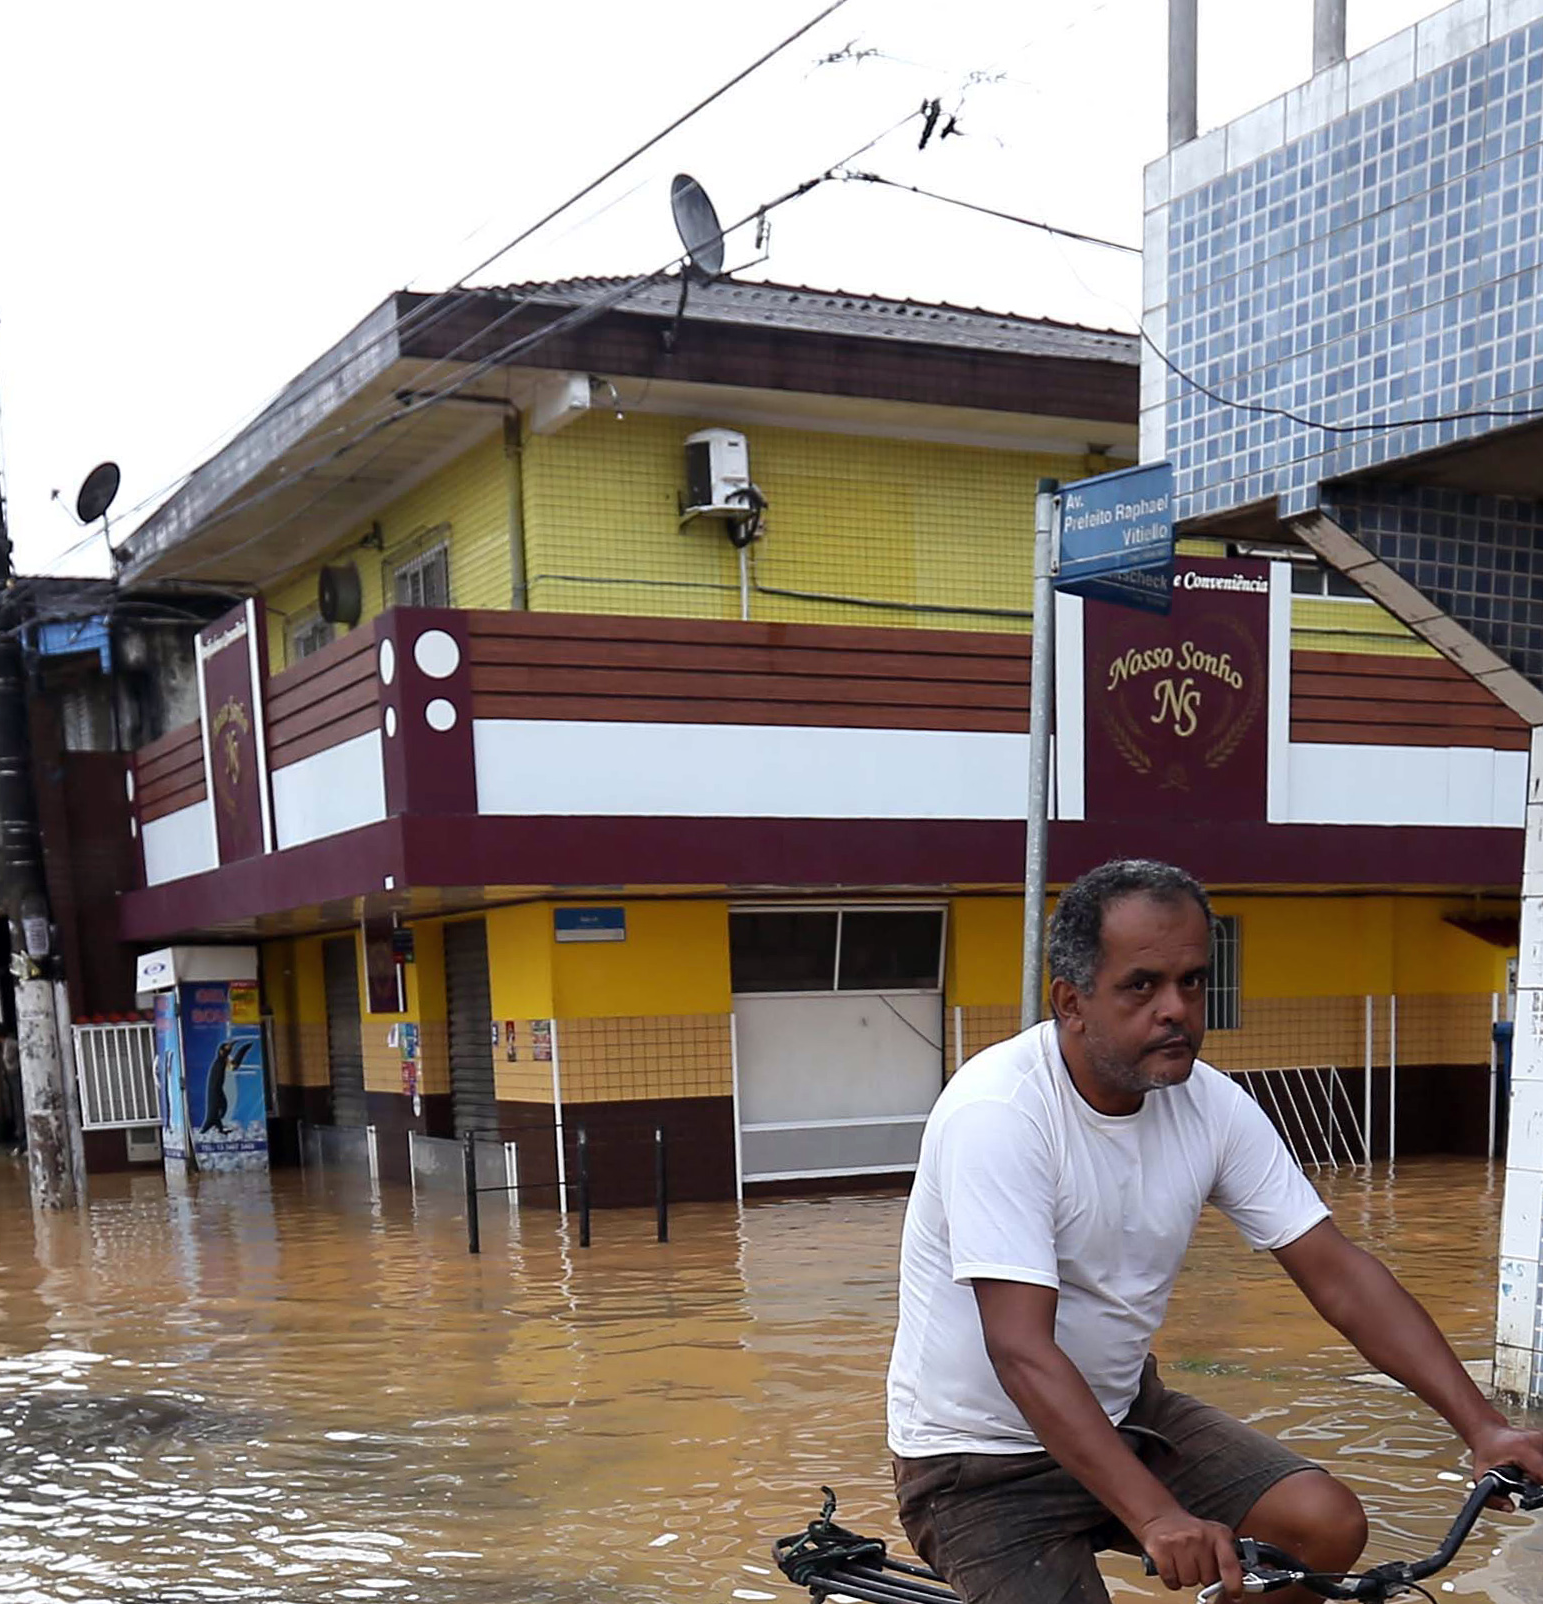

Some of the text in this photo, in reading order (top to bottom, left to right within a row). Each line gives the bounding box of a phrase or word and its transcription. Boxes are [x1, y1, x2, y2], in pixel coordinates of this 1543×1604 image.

[1064, 494, 1169, 533] Prefeito Raphael
[1065, 494, 1085, 511] Av.
[1122, 523, 1168, 546] Vitiello
[1109, 569, 1168, 591] scheck
[1173, 571, 1268, 594] e Conveniência
[1107, 641, 1243, 691] Nosso Sonho
[1150, 677, 1201, 737] NS
